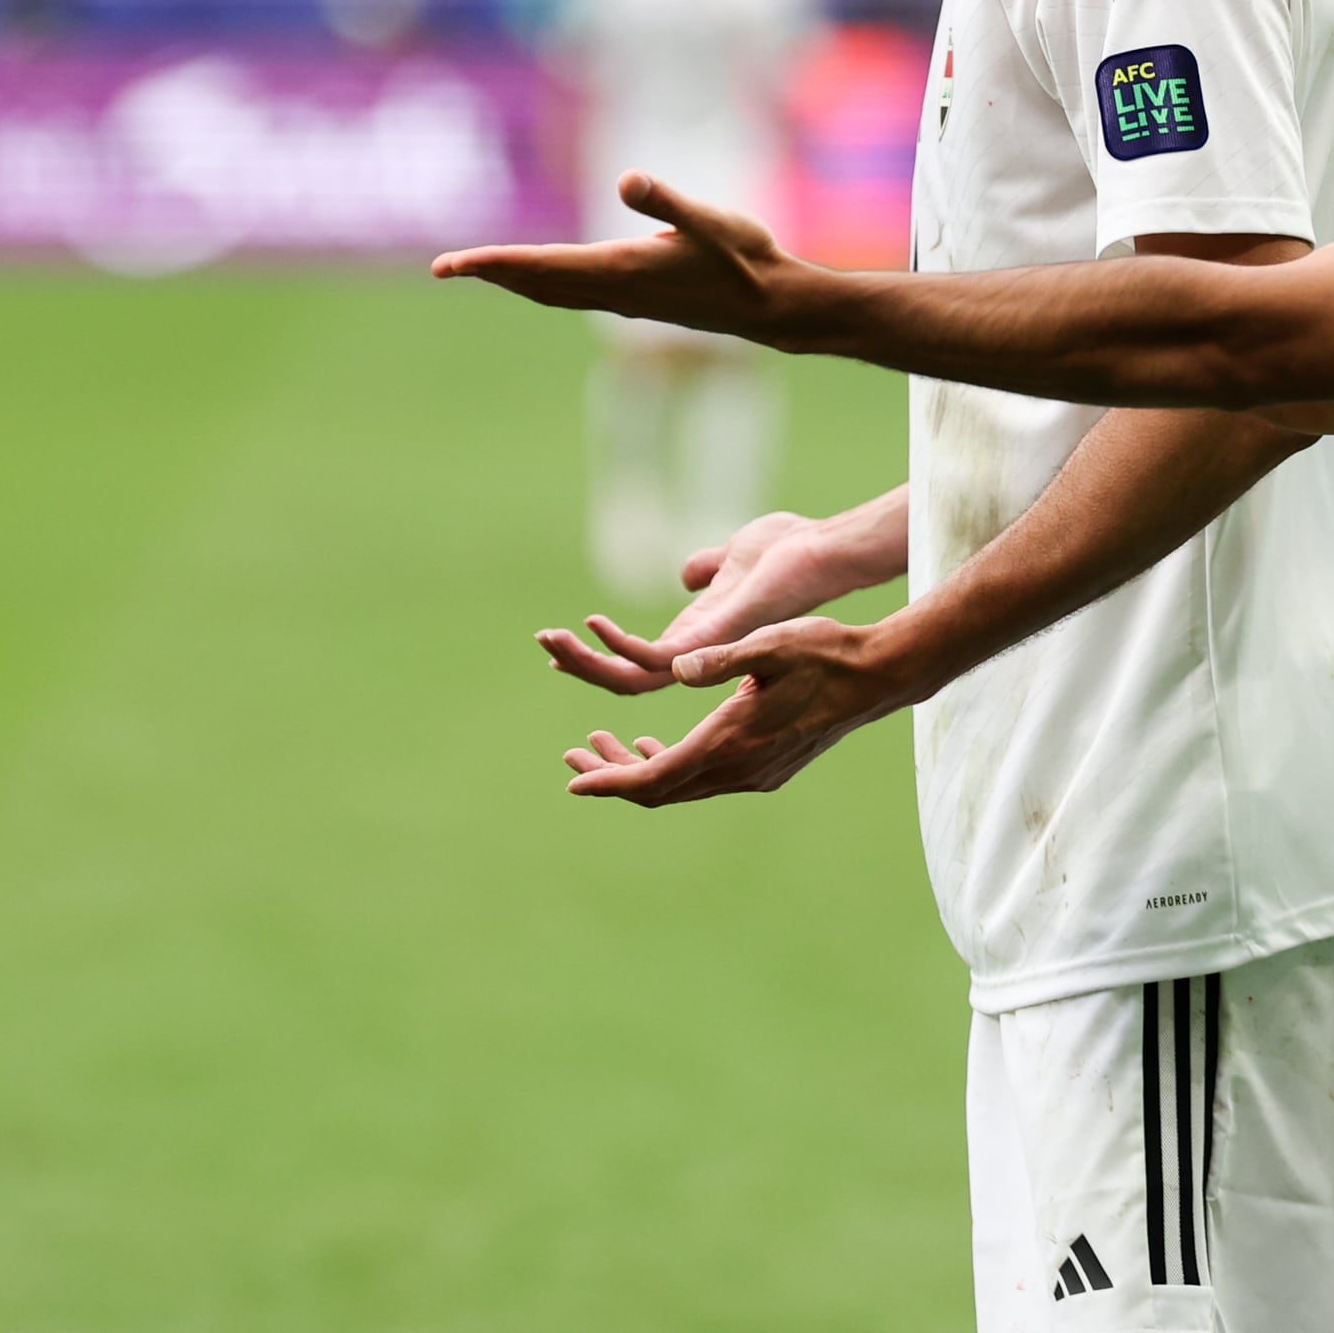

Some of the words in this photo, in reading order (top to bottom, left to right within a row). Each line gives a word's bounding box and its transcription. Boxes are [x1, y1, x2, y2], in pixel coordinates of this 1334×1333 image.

[1112, 62, 1156, 86] AFC
[1113, 78, 1190, 115] LIVE
[1146, 891, 1207, 909] AEROREADY
